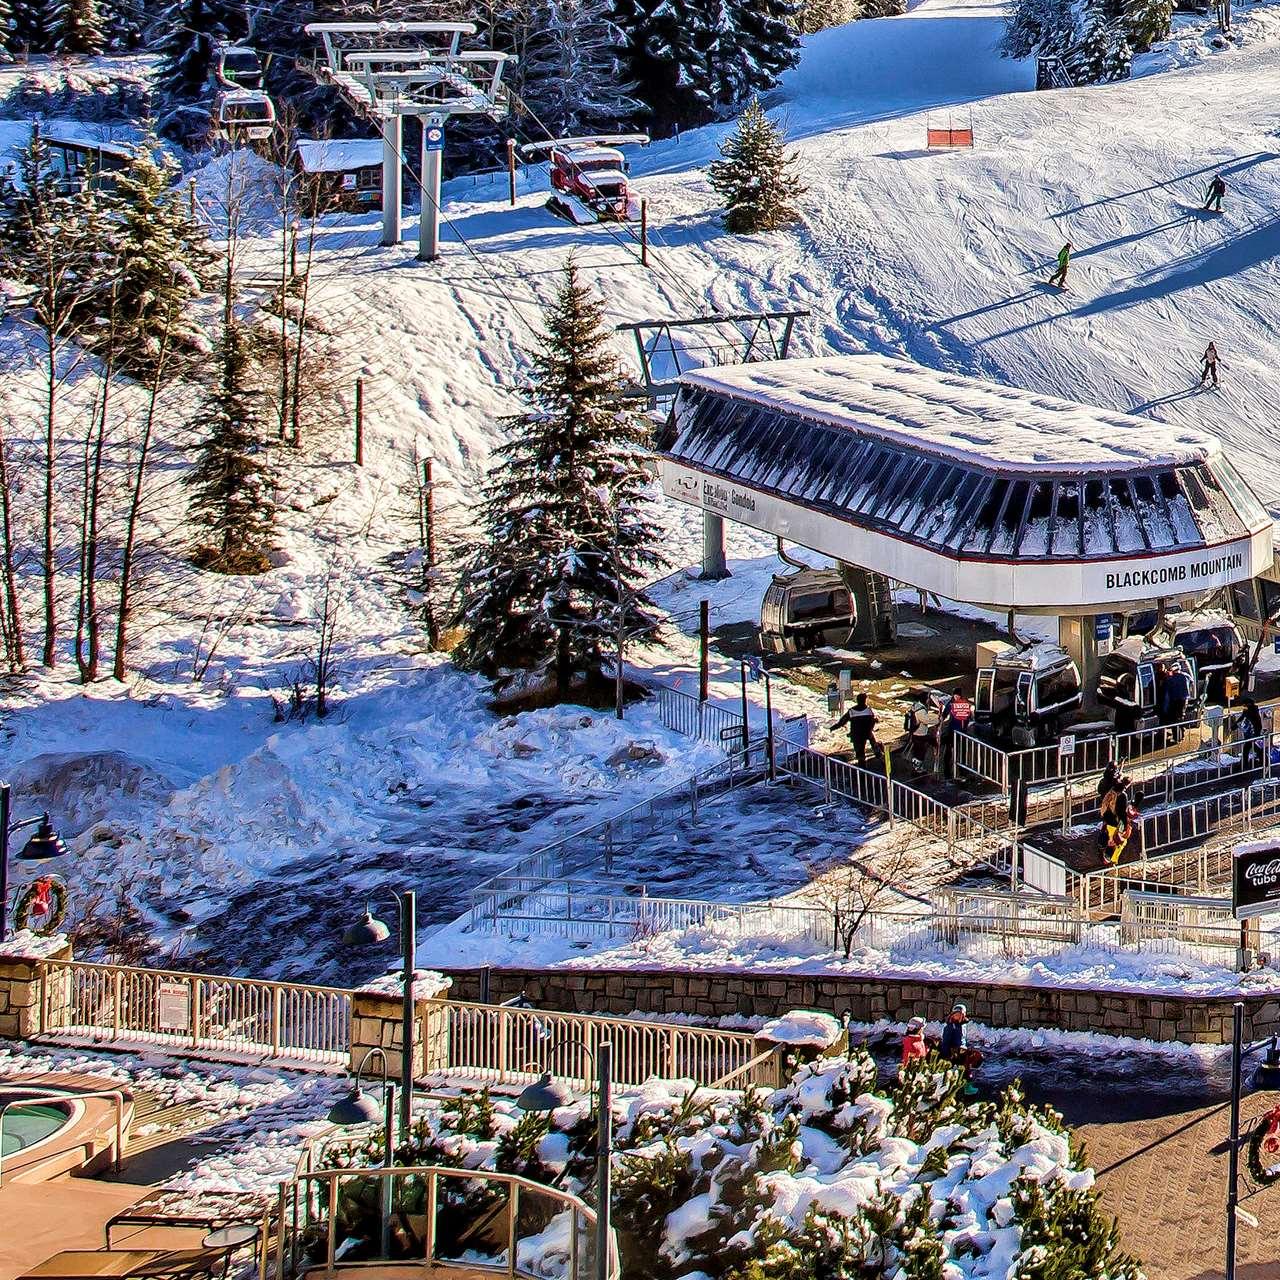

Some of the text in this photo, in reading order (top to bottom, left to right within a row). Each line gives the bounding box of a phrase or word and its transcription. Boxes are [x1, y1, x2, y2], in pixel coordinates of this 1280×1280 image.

[1106, 553, 1242, 589] BLACKCOMB MOUNTAIN
[1252, 874, 1278, 887] tube
